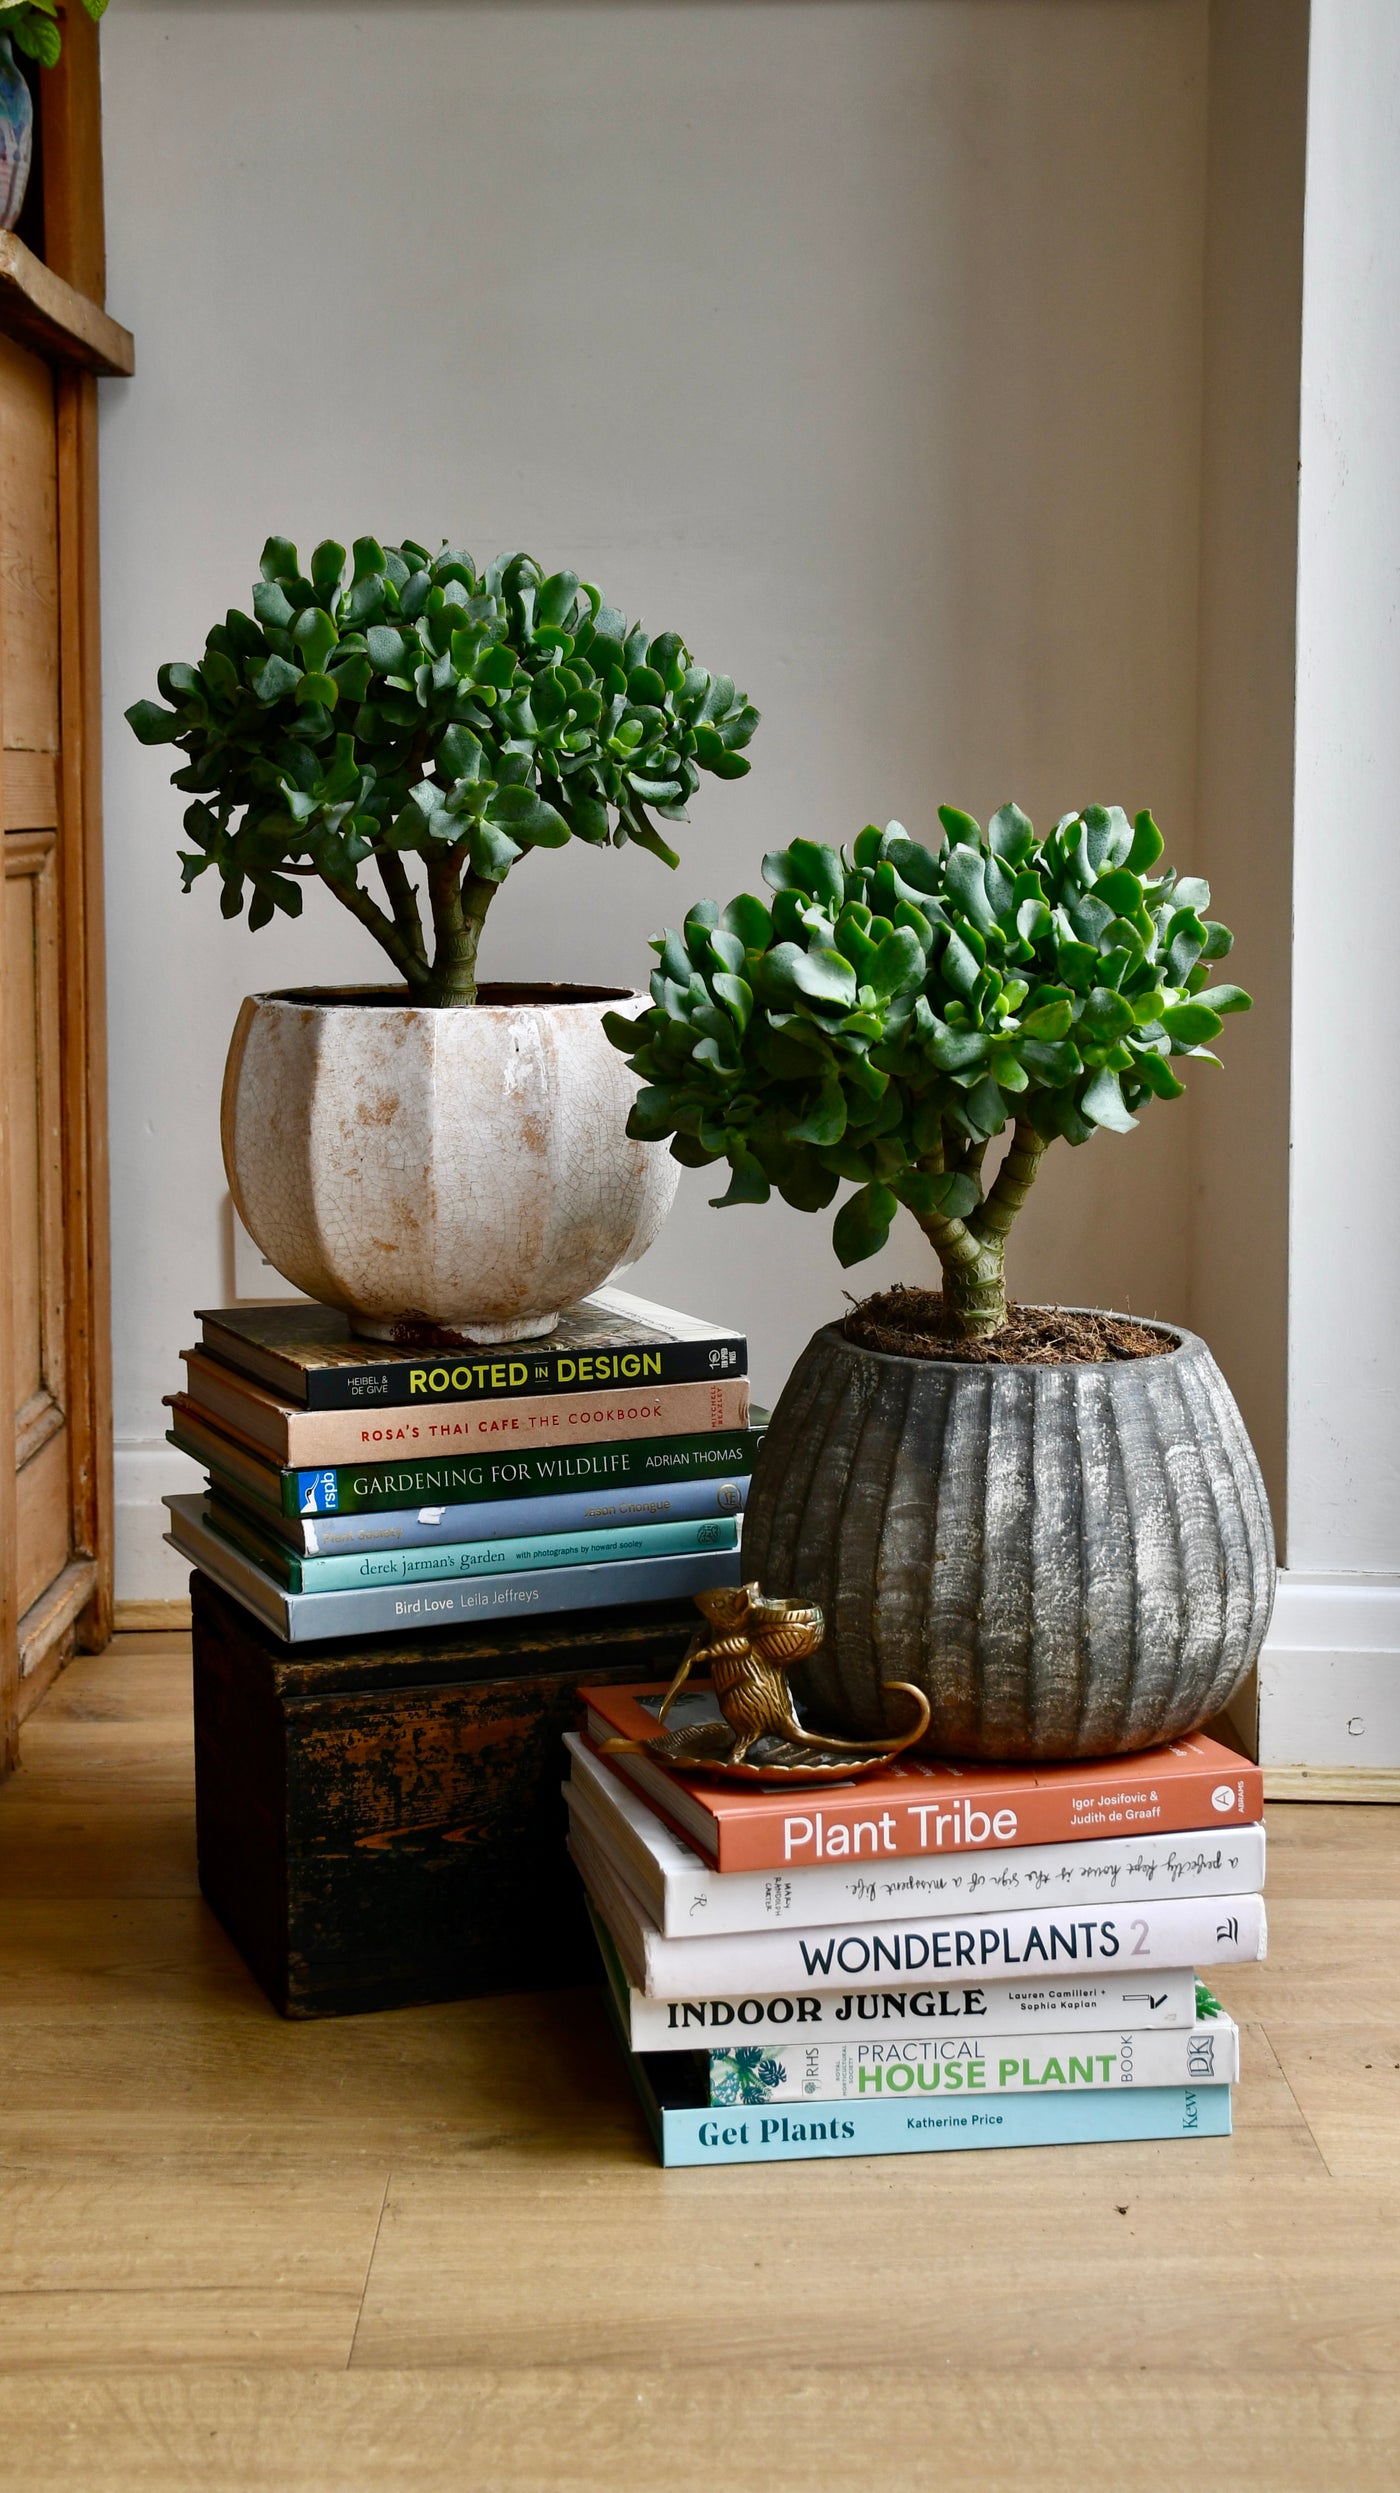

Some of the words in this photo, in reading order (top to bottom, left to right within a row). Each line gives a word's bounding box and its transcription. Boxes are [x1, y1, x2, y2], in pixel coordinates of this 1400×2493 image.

[347, 1376, 379, 1387] HEIBEL
[381, 1375, 388, 1384] &
[410, 1363, 528, 1394] ROOTED
[535, 1366, 549, 1379] IN
[557, 1352, 662, 1383] DESIGN
[351, 1386, 364, 1396] DE
[366, 1384, 389, 1395] GIVE
[361, 1424, 420, 1442] ROSA'S
[429, 1422, 468, 1437] THAI
[478, 1418, 520, 1433] CAFE
[528, 1415, 560, 1428] THE
[568, 1405, 662, 1425] COOKBOOK
[353, 1466, 483, 1496] GARDENING
[491, 1463, 532, 1483] FOR
[536, 1453, 631, 1479] WILDLIFE
[645, 1452, 690, 1469] ADRIAN
[692, 1448, 743, 1464] THOMAS
[320, 1471, 338, 1509] rspb
[584, 1505, 617, 1518] Jason
[360, 1558, 398, 1576] derek
[402, 1555, 455, 1577] jarman's
[459, 1550, 506, 1571] garden
[515, 1550, 531, 1560] with
[533, 1545, 579, 1560] photographs
[580, 1543, 590, 1555] by
[591, 1541, 618, 1552] howard
[619, 1540, 643, 1551] sooley
[395, 1599, 421, 1616] Bird
[424, 1597, 454, 1612] Love
[460, 1592, 489, 1609] Leila
[492, 1588, 539, 1605] Jeffreys
[1072, 1797, 1095, 1811] Igor
[1097, 1790, 1147, 1806] Josifovic
[1149, 1790, 1159, 1801] &
[1237, 1780, 1245, 1813] ABRAMS
[1070, 1812, 1106, 1826] Judith
[1108, 1810, 1123, 1821] de
[1125, 1806, 1161, 1820] Graaff
[784, 1811, 897, 1860] Plant
[907, 1799, 1018, 1848] Tribe
[1055, 1866, 1074, 1883] is
[1080, 1863, 1121, 1888] house
[1126, 1854, 1158, 1883] kept
[1161, 1850, 1222, 1883] perfectly
[1228, 1858, 1239, 1869] a
[880, 1875, 947, 1895] misspent
[951, 1876, 963, 1888] a
[968, 1872, 986, 1893] of
[990, 1867, 1020, 1890] sign
[1024, 1873, 1051, 1890] the
[689, 1893, 708, 1917] R
[799, 1920, 1120, 1976] WONDERPLANTS
[1130, 1918, 1151, 1956] 2
[1008, 1990, 1045, 2000] Lauren
[1048, 1988, 1097, 1999] Camilleri
[1020, 2001, 1057, 2012] Sophia
[1060, 2000, 1097, 2011] Kaplan
[667, 1996, 823, 2028] INDOOR
[835, 1988, 988, 2021] JUNGLE
[805, 2047, 819, 2077] RHS
[858, 2040, 985, 2063] PRACTICAL
[1120, 2034, 1133, 2082] BOOK
[1188, 2037, 1210, 2074] DK
[858, 2060, 986, 2093] HOUSE
[999, 2055, 1117, 2087] PLANT
[907, 2115, 968, 2129] Katherine
[971, 2113, 1003, 2125] Price
[1182, 2089, 1198, 2129] Kew
[698, 2121, 750, 2147] Get
[760, 2117, 855, 2144] Plants
